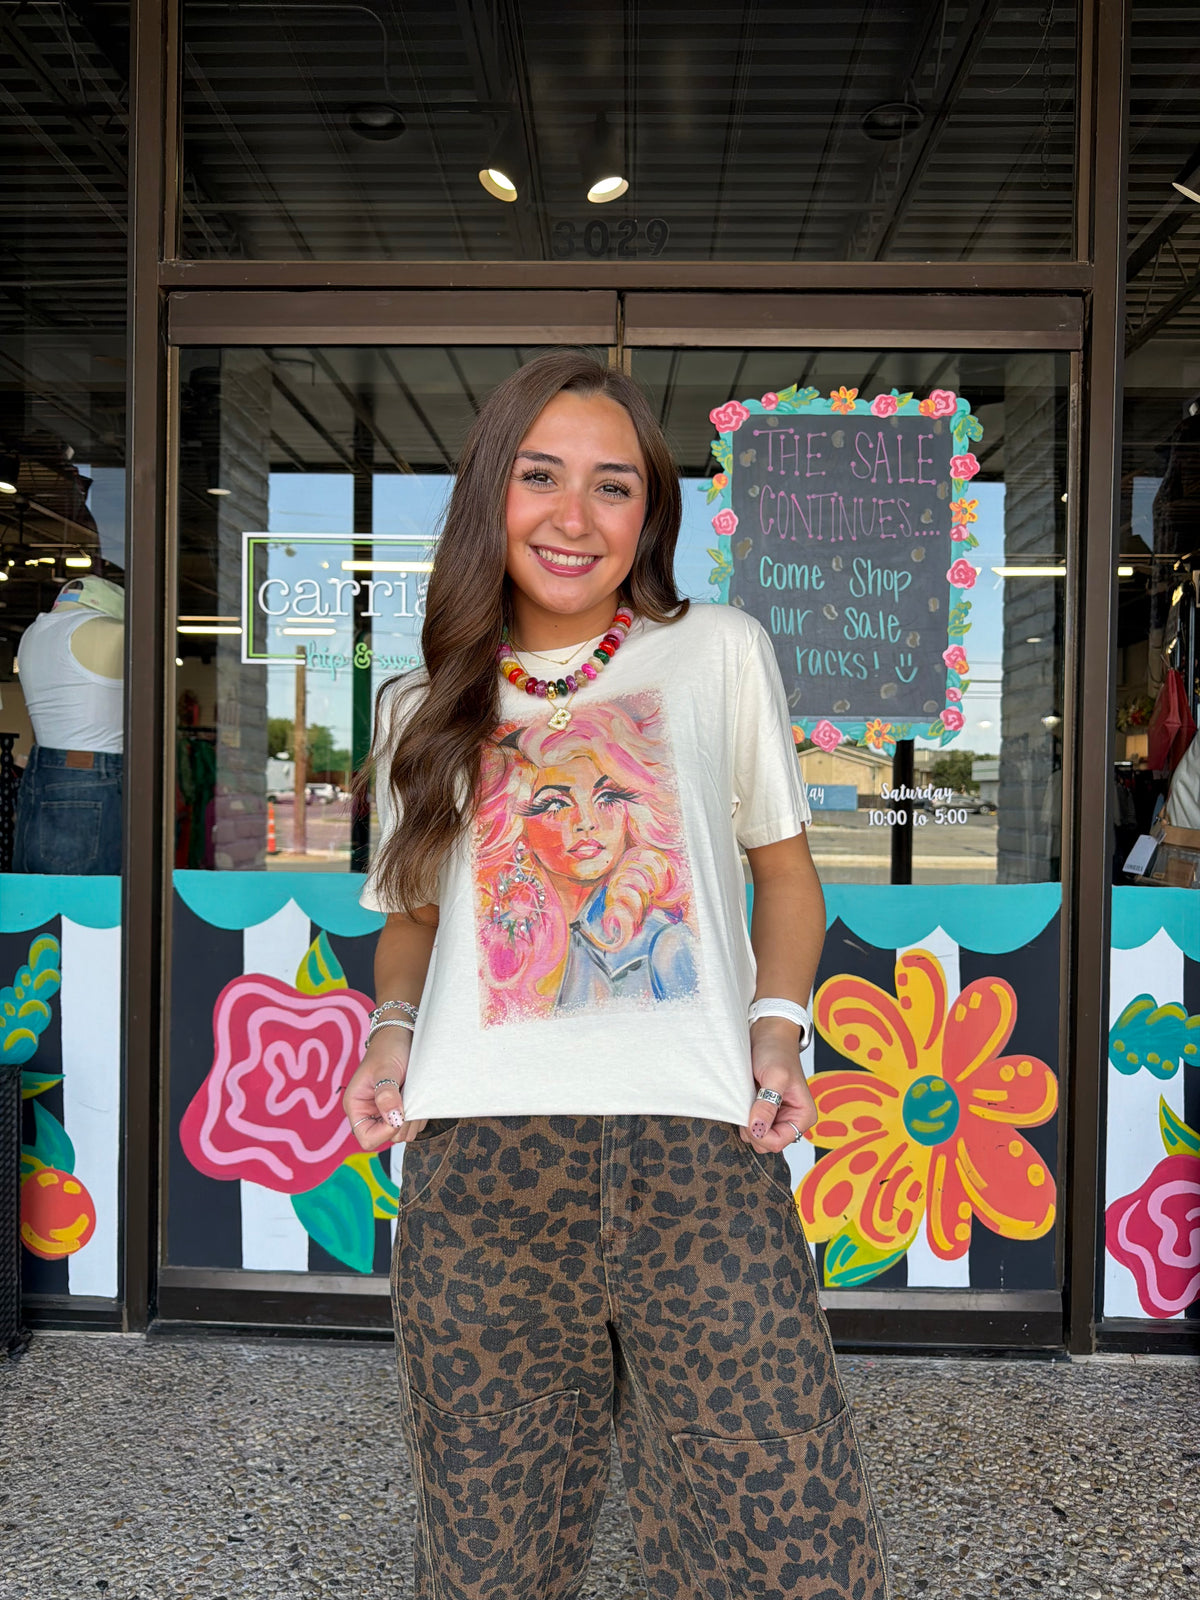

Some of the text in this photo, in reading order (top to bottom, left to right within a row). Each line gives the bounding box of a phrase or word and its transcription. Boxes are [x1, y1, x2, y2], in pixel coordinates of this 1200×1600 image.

[552, 217, 670, 257] 3029
[753, 428, 937, 485] THE SALE
[759, 555, 912, 602] Come Shop
[770, 605, 813, 636] our
[305, 639, 350, 682] hip
[353, 642, 374, 669] &
[796, 645, 881, 681] racks!
[880, 782, 954, 804] Saturday
[868, 808, 968, 827] 10:00 to 5:00
